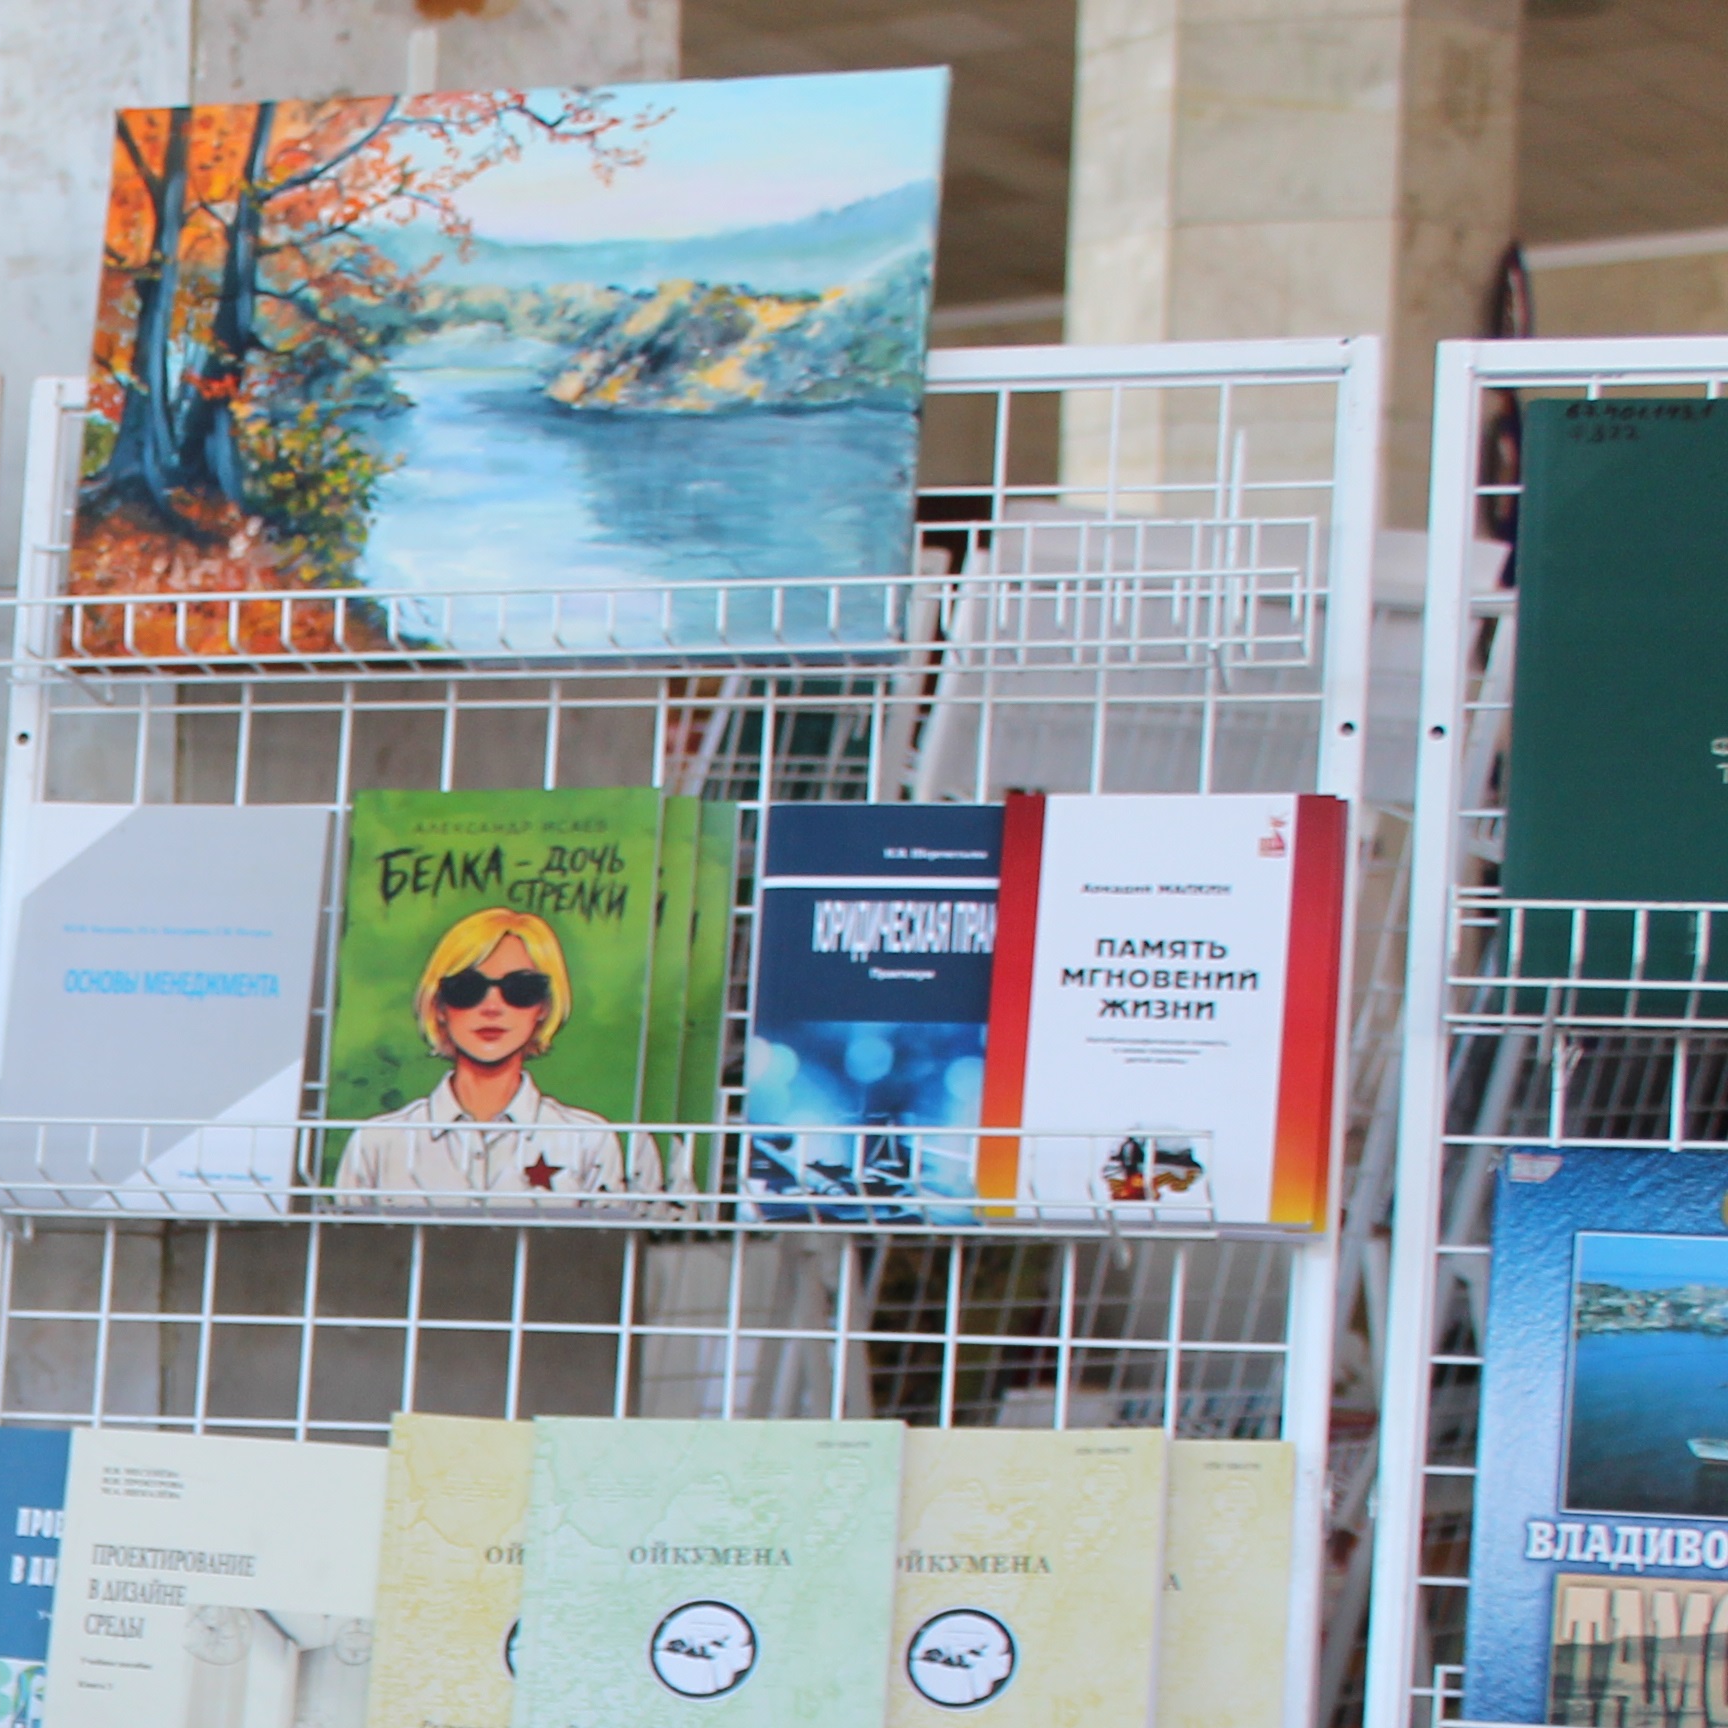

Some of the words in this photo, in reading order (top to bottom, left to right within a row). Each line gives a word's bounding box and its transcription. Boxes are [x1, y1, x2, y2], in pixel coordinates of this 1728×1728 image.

[376, 844, 505, 907] БЕЛКА
[540, 842, 626, 877] ДОЧЬ
[507, 878, 630, 923] СТРЕЛКИ
[1095, 939, 1229, 960] ПАМЯТЬ
[64, 969, 141, 993] ОСНОВЫ
[145, 970, 280, 1001] МЕНЕДЖМЕНТА
[1059, 967, 1260, 991] МГНОВЕНИЙ
[1100, 999, 1216, 1021] ЖИЗНИ
[92, 1543, 256, 1578] ПРОЕКТИРОВАНИЕ
[629, 1545, 793, 1567] ОЙКУМЕНА
[1525, 1521, 1728, 1571] ВЛАДИВО
[88, 1579, 99, 1600] В
[102, 1578, 187, 1607] ДИЗАЙНЕ
[84, 1614, 144, 1640] СРЕДЫ
